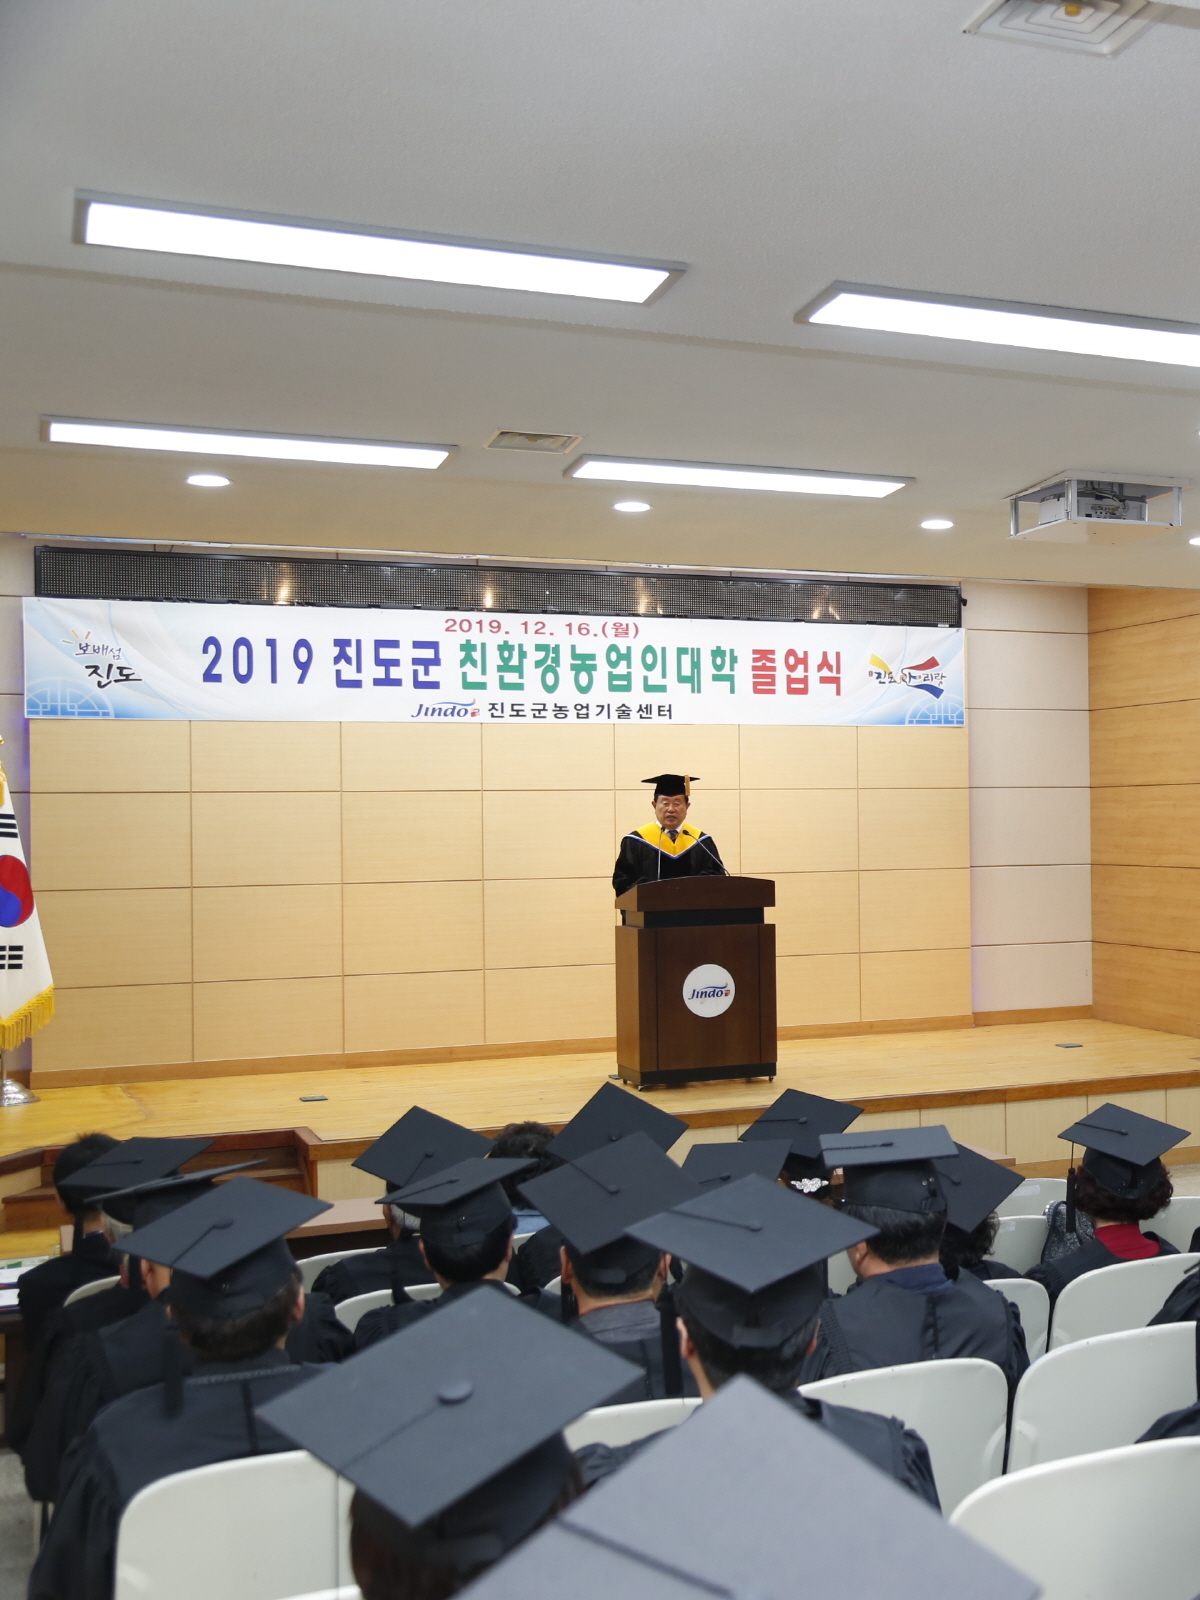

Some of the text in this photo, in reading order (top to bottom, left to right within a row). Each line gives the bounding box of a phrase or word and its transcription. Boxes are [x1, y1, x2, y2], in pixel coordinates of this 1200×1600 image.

[444, 618, 510, 635] 2019.
[520, 620, 555, 636] 12.
[75, 642, 122, 661] 보배섬
[201, 635, 842, 697] 2019 진도군 친환경농업인대학 졸업식
[84, 663, 143, 690] 진도
[411, 702, 470, 718] Jindo
[487, 701, 673, 720] 진도군농업기술센터
[688, 988, 723, 1000] Jindo
